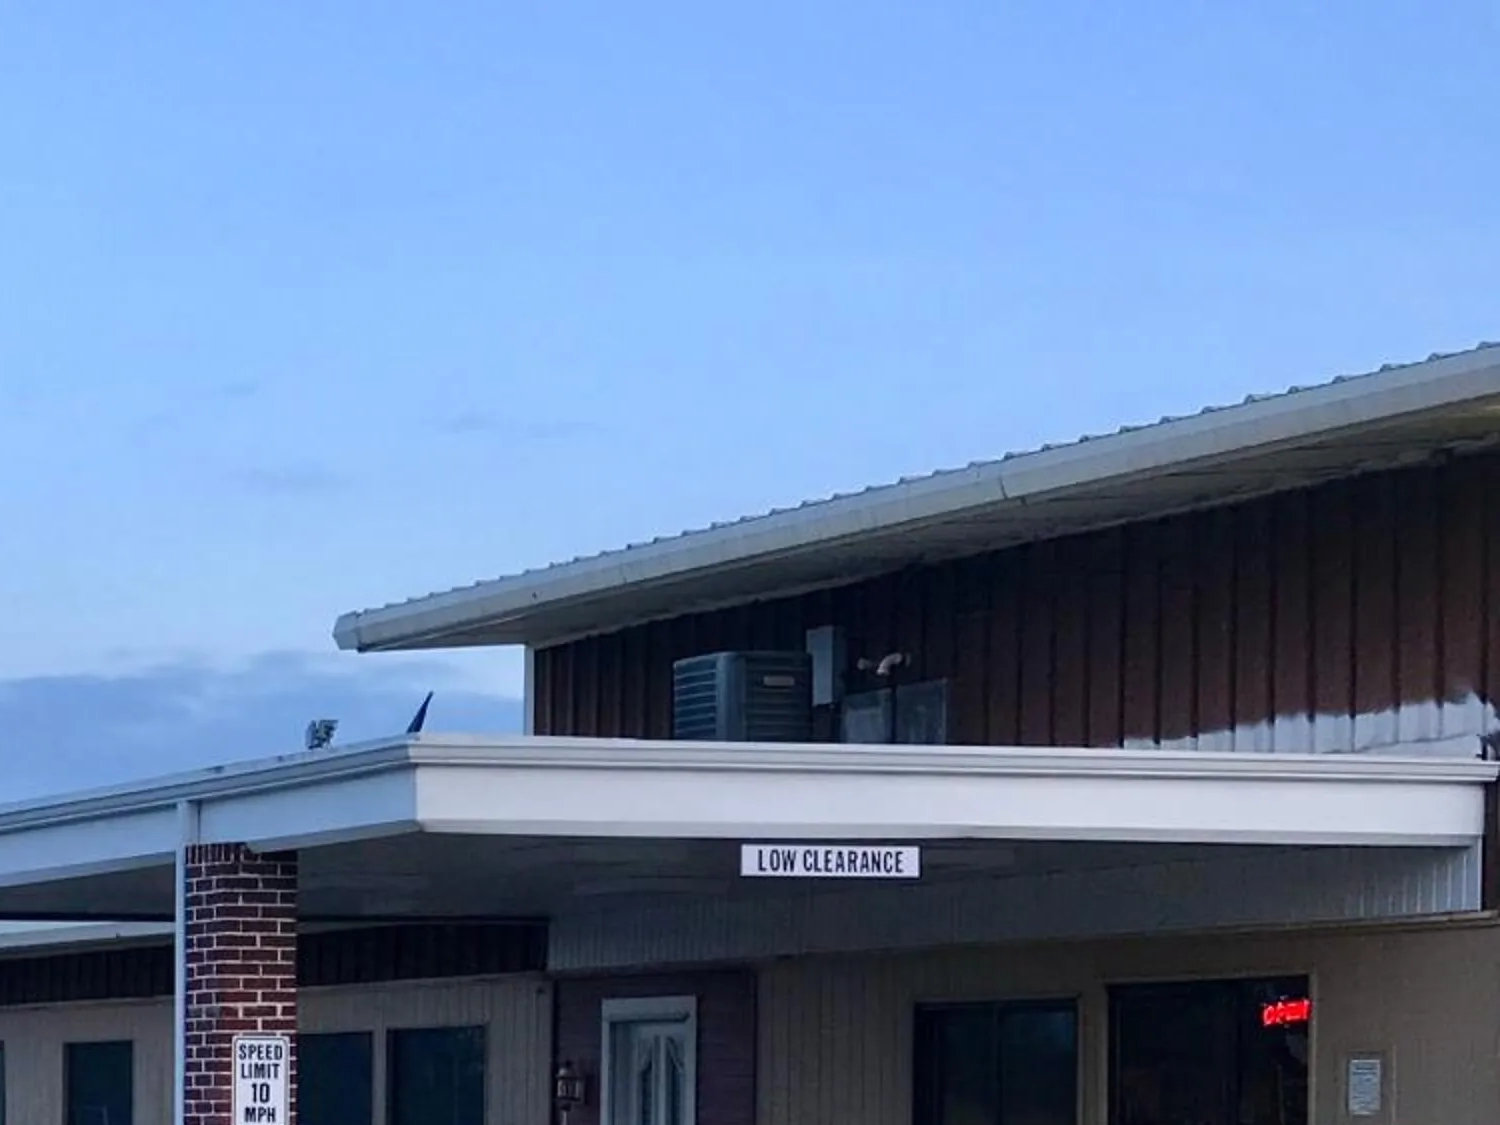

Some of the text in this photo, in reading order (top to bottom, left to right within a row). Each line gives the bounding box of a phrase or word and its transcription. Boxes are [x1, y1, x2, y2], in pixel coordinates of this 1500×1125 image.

[757, 848, 905, 874] LOW CLEARANCE
[238, 1043, 283, 1061] SPEED
[241, 1062, 281, 1080] LIMIT
[251, 1082, 271, 1104] 10
[244, 1106, 277, 1123] MPH
